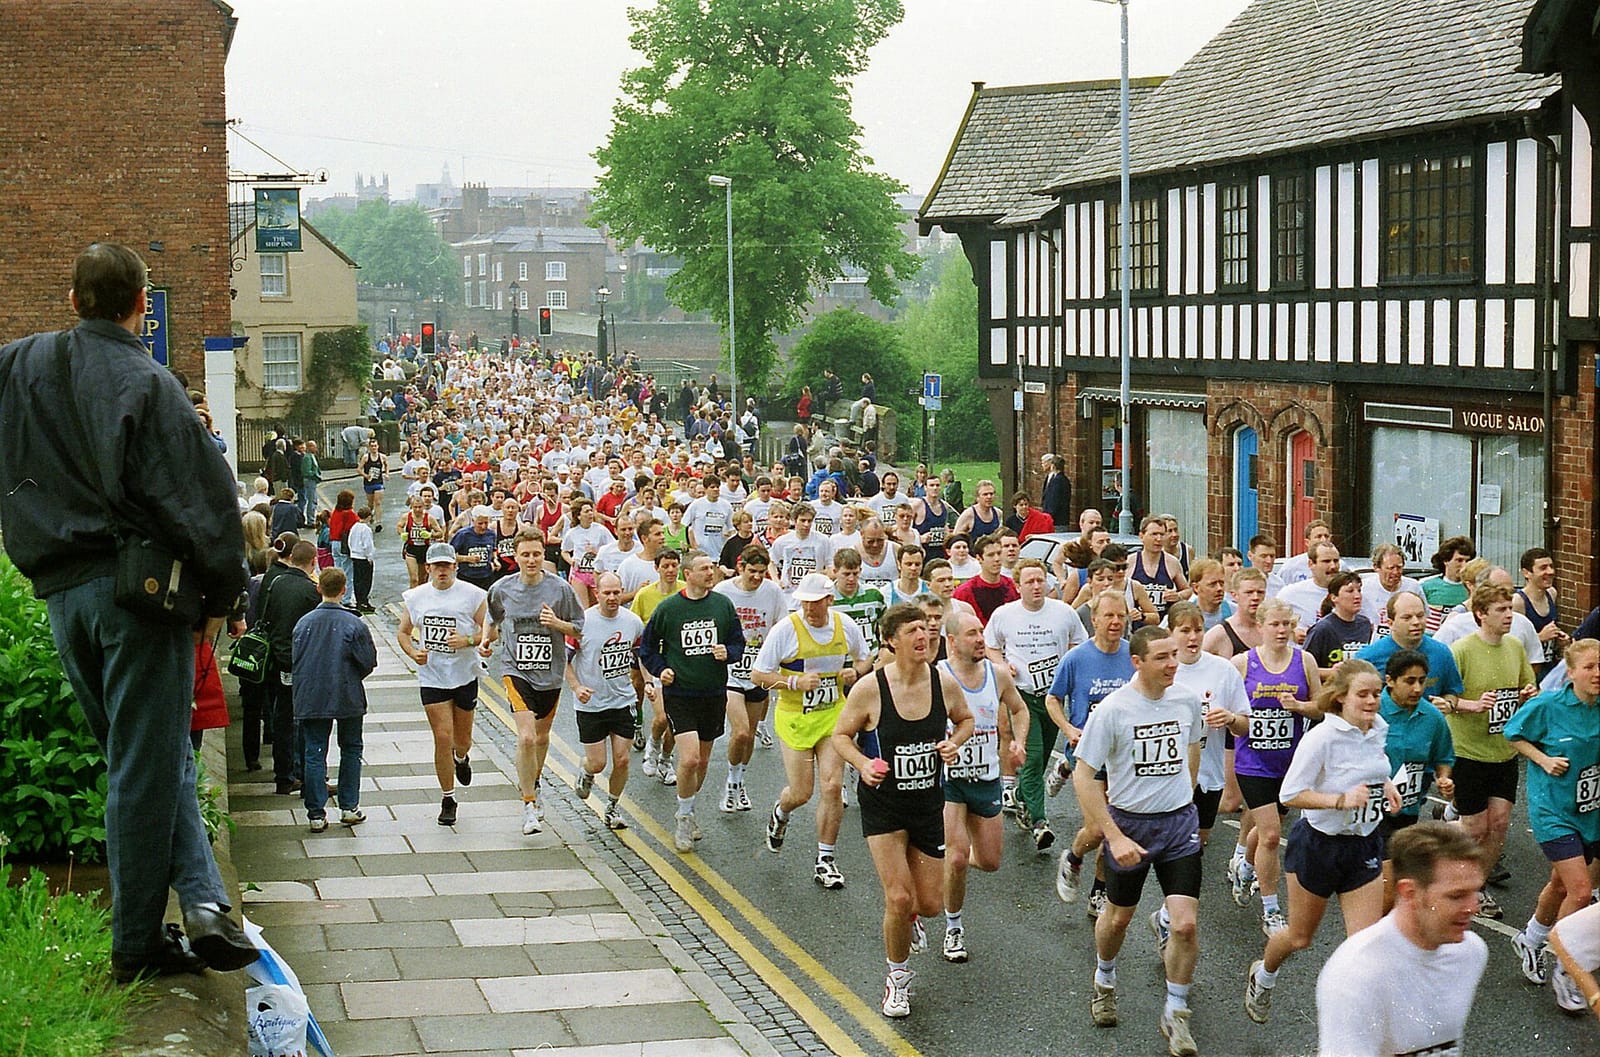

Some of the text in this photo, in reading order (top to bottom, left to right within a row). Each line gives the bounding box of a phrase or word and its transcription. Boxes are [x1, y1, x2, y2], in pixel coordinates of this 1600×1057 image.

[1462, 411, 1503, 429] VOGUE
[425, 617, 456, 626] adidas
[683, 619, 716, 630] adidas
[519, 634, 551, 644] adidas
[684, 629, 713, 646] 669
[519, 644, 551, 660] 1378
[602, 641, 630, 653] adidas
[518, 662, 550, 671] adidas
[604, 652, 630, 669] 1226
[1029, 657, 1060, 672] adidas
[603, 667, 629, 679] adidas
[804, 689, 834, 705] 921
[1251, 708, 1292, 719] adidas
[1136, 725, 1179, 738] adidas
[1252, 720, 1289, 737] 856
[895, 742, 937, 755] adidas
[1142, 738, 1178, 762] 178
[1251, 740, 1292, 750] adidas
[896, 752, 936, 777] 1040
[1137, 764, 1181, 777] adidas
[897, 778, 935, 791] adidas
